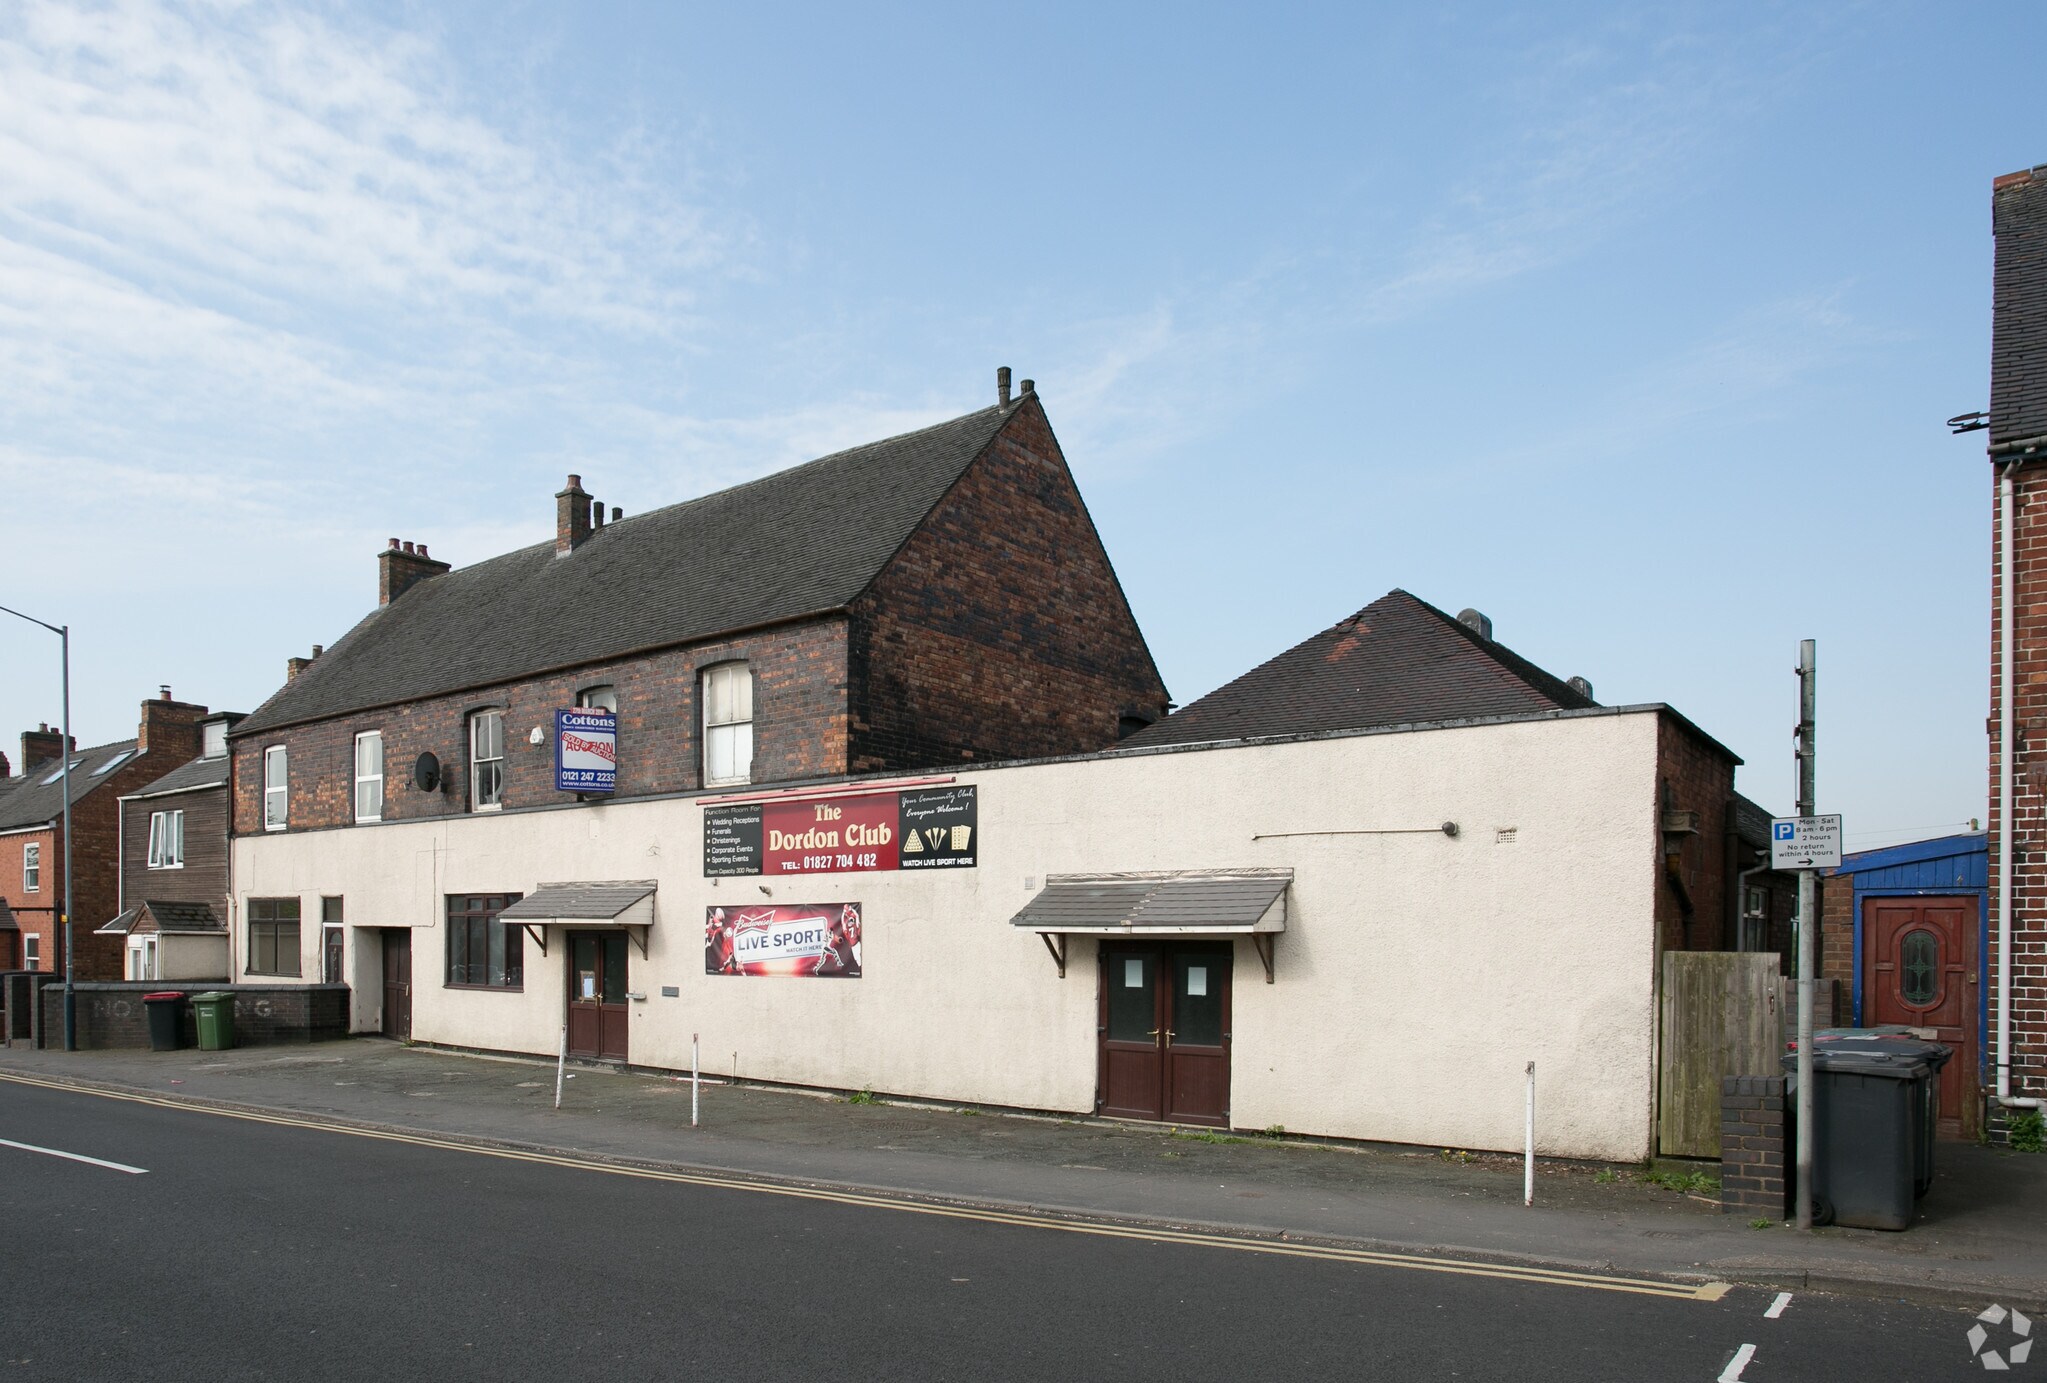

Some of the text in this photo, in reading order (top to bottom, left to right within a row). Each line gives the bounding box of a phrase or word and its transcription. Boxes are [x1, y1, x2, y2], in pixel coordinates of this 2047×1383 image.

[562, 714, 615, 727] Cottons
[564, 734, 617, 762] SOLD BY AUCTION
[562, 771, 615, 781] 0121 247 2233
[902, 796, 916, 808] Your
[919, 792, 955, 803] Community
[814, 804, 842, 821] The
[906, 808, 935, 820] Everyone
[712, 816, 759, 826] Wedding Receptions
[769, 822, 892, 851] Dordon Club
[1779, 825, 1792, 839] P
[712, 856, 731, 864] Sporting
[781, 853, 876, 870] TEL: 01827 704 482
[738, 929, 823, 950] LIVE SPORT
